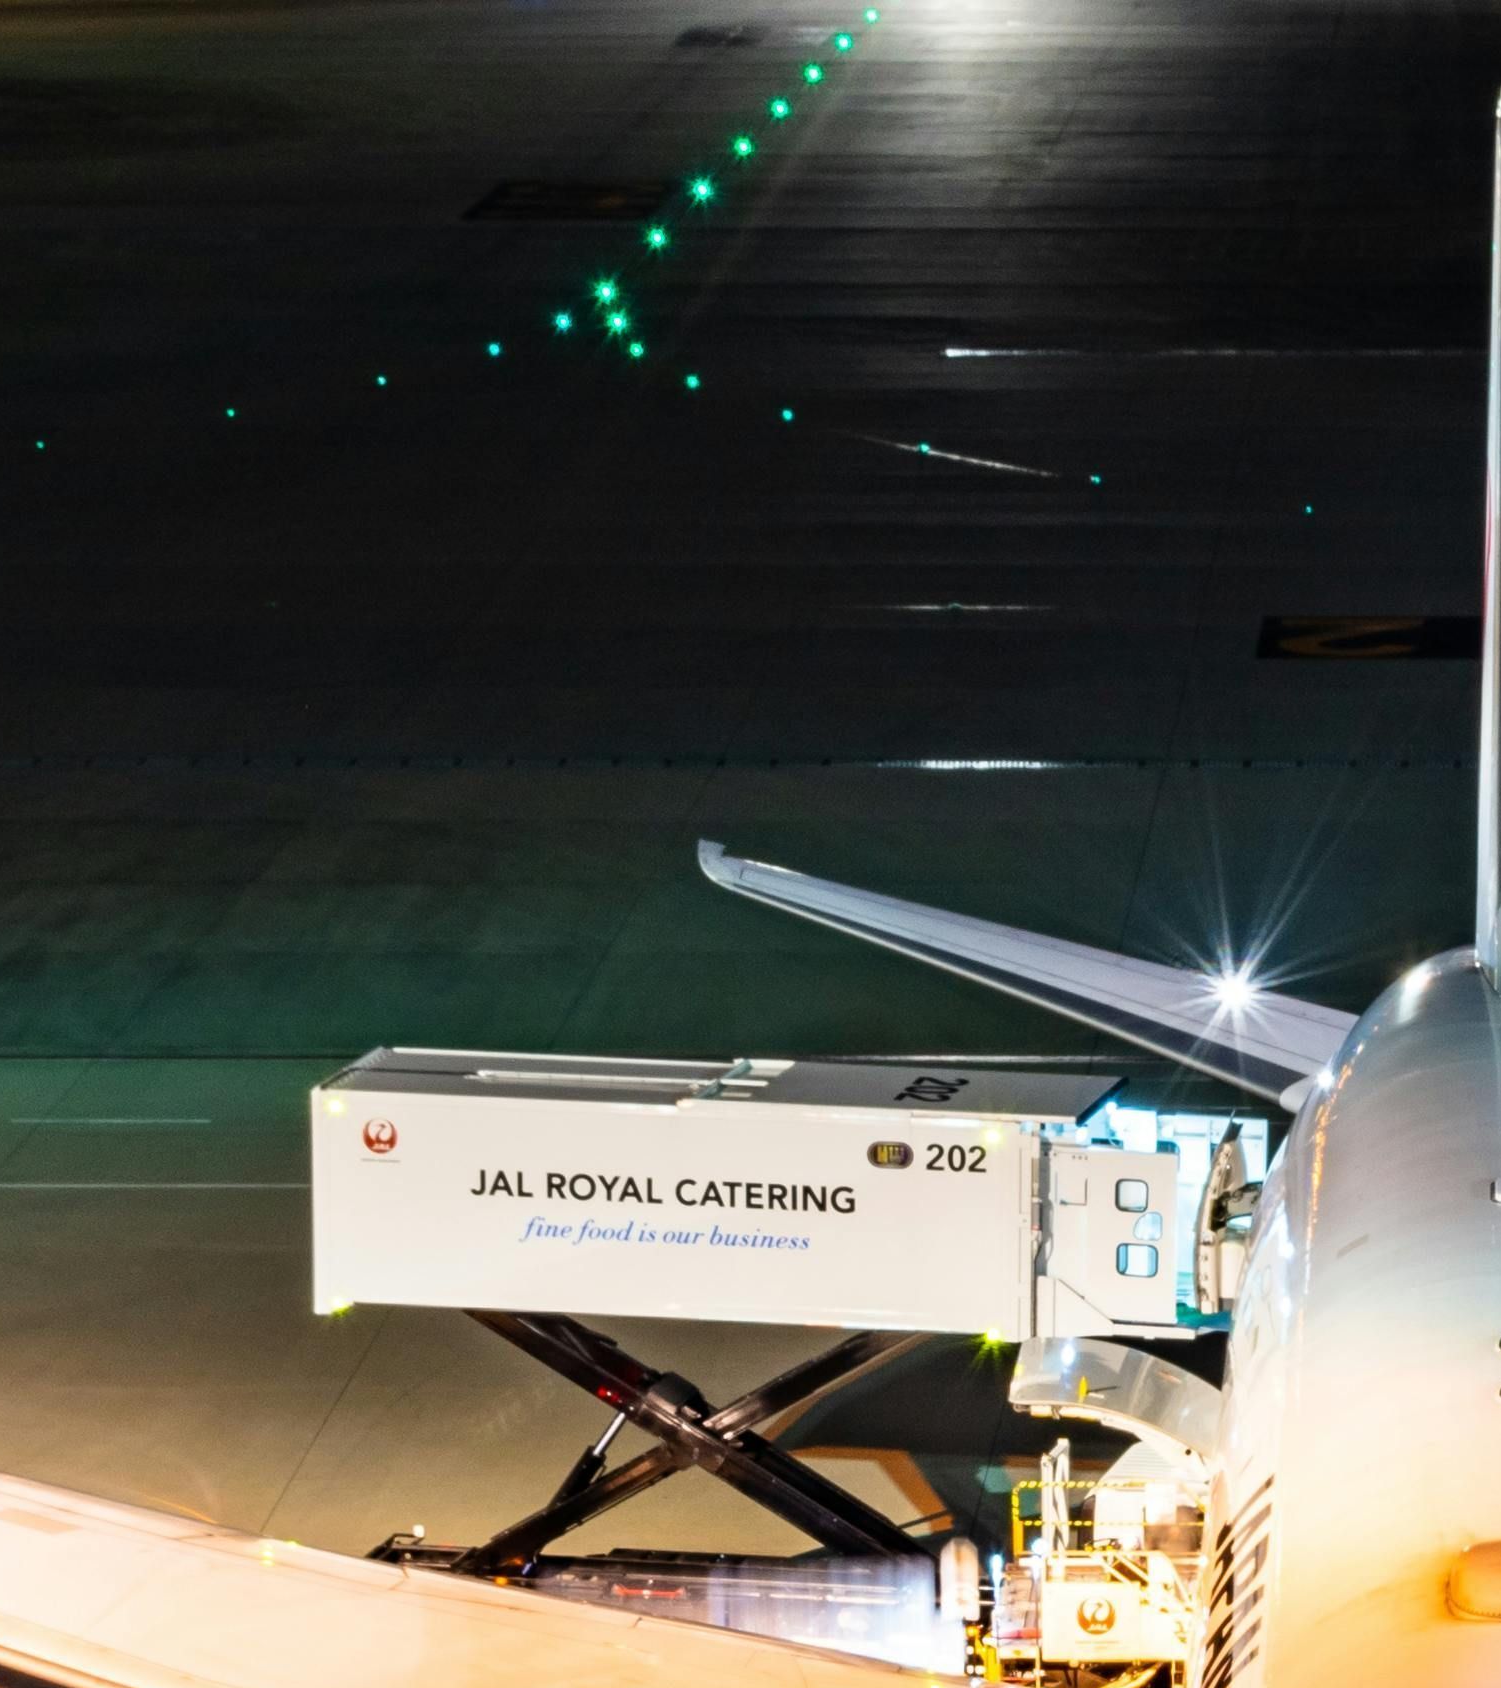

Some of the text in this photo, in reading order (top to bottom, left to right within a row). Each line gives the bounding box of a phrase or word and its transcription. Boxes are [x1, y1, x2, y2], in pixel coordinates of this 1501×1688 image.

[893, 1076, 970, 1102] 202
[925, 1143, 987, 1173] 202
[470, 1169, 856, 1214] JAL ROYAL CATERING
[518, 1215, 810, 1250] fine food is our business
